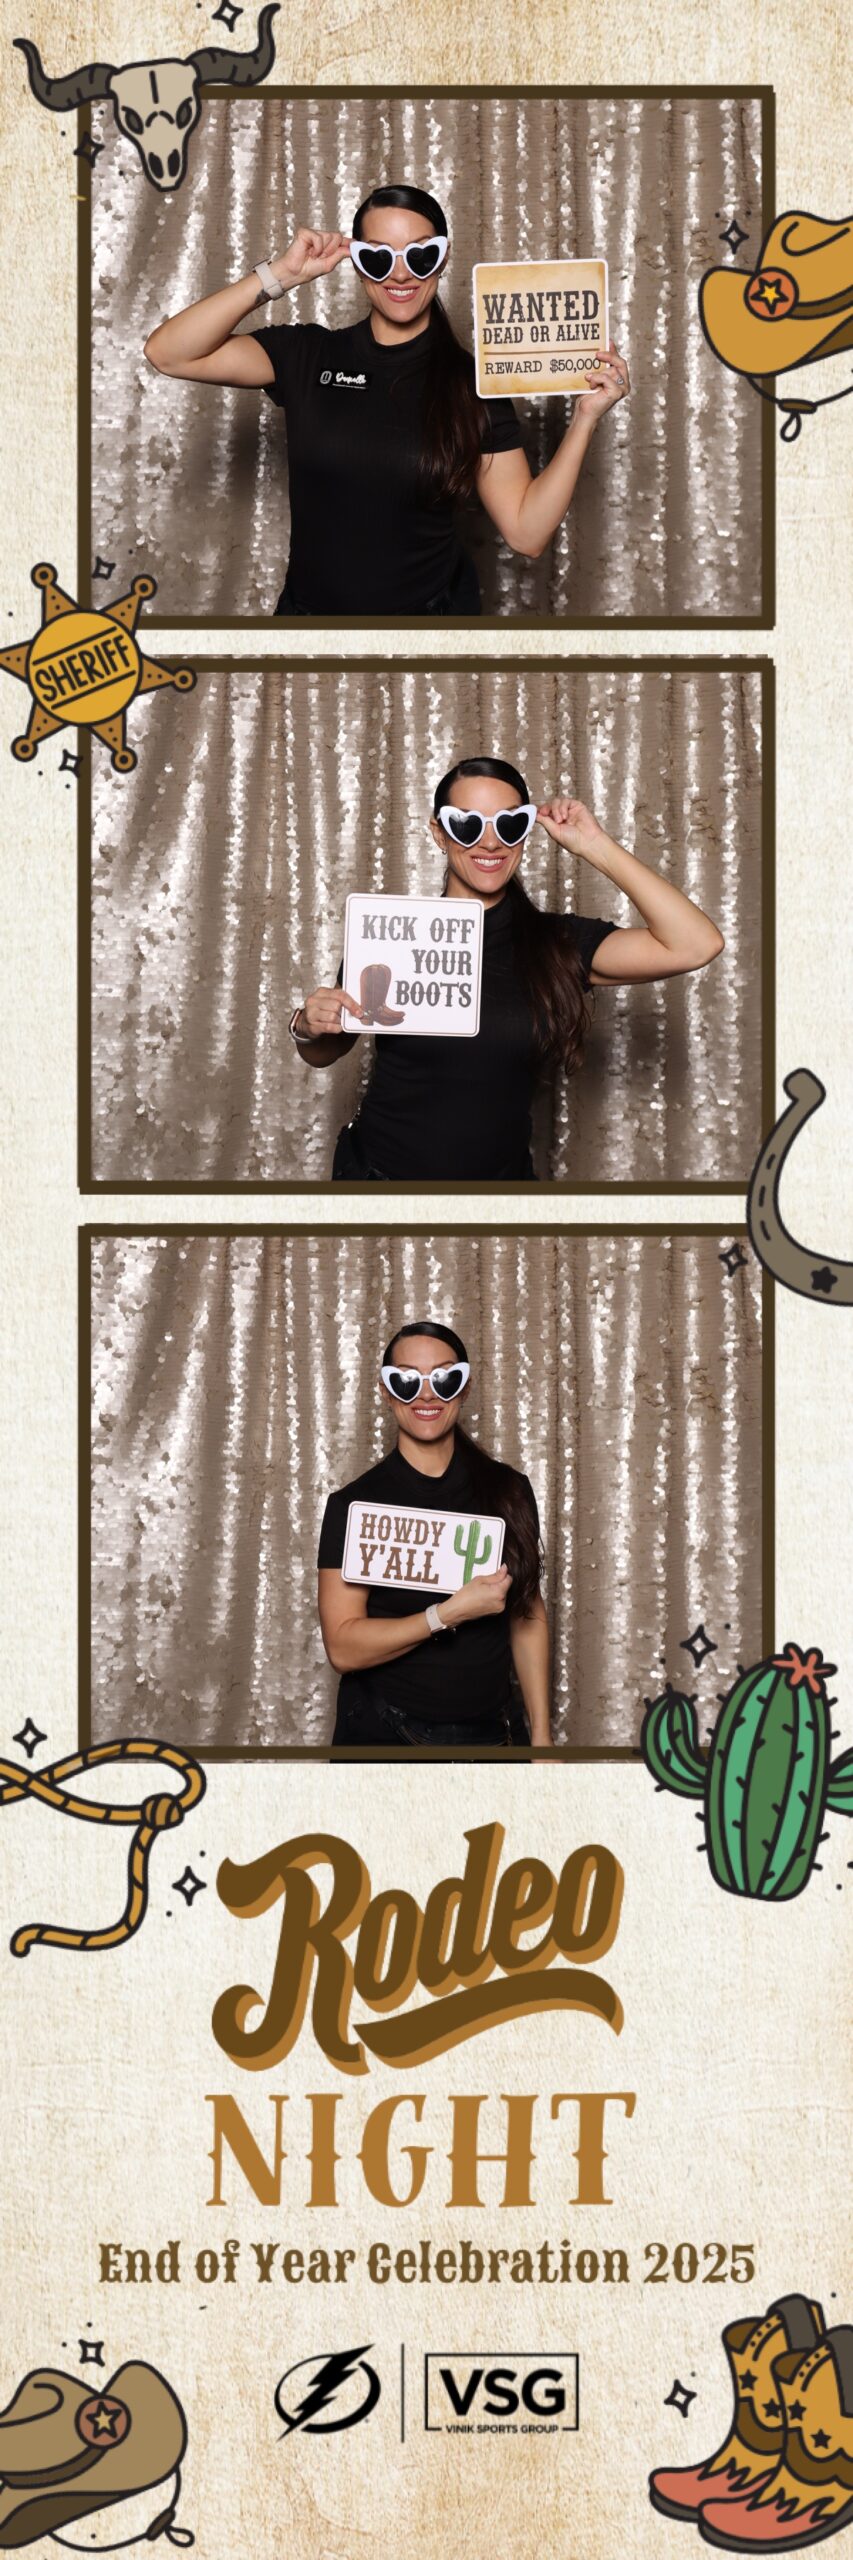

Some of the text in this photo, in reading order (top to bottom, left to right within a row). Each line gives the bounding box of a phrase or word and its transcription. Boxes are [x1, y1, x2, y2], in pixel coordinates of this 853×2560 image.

[482, 290, 600, 324] WANTED
[482, 323, 600, 345] DEAD OR ALIVE
[485, 357, 601, 375] REWARD $50,000
[361, 914, 475, 944] KICK OFF
[411, 949, 473, 976] YOUR
[395, 980, 472, 1008] BOOTS
[359, 1512, 446, 1548] HOWDY
[359, 1543, 440, 1585] Y'ALL
